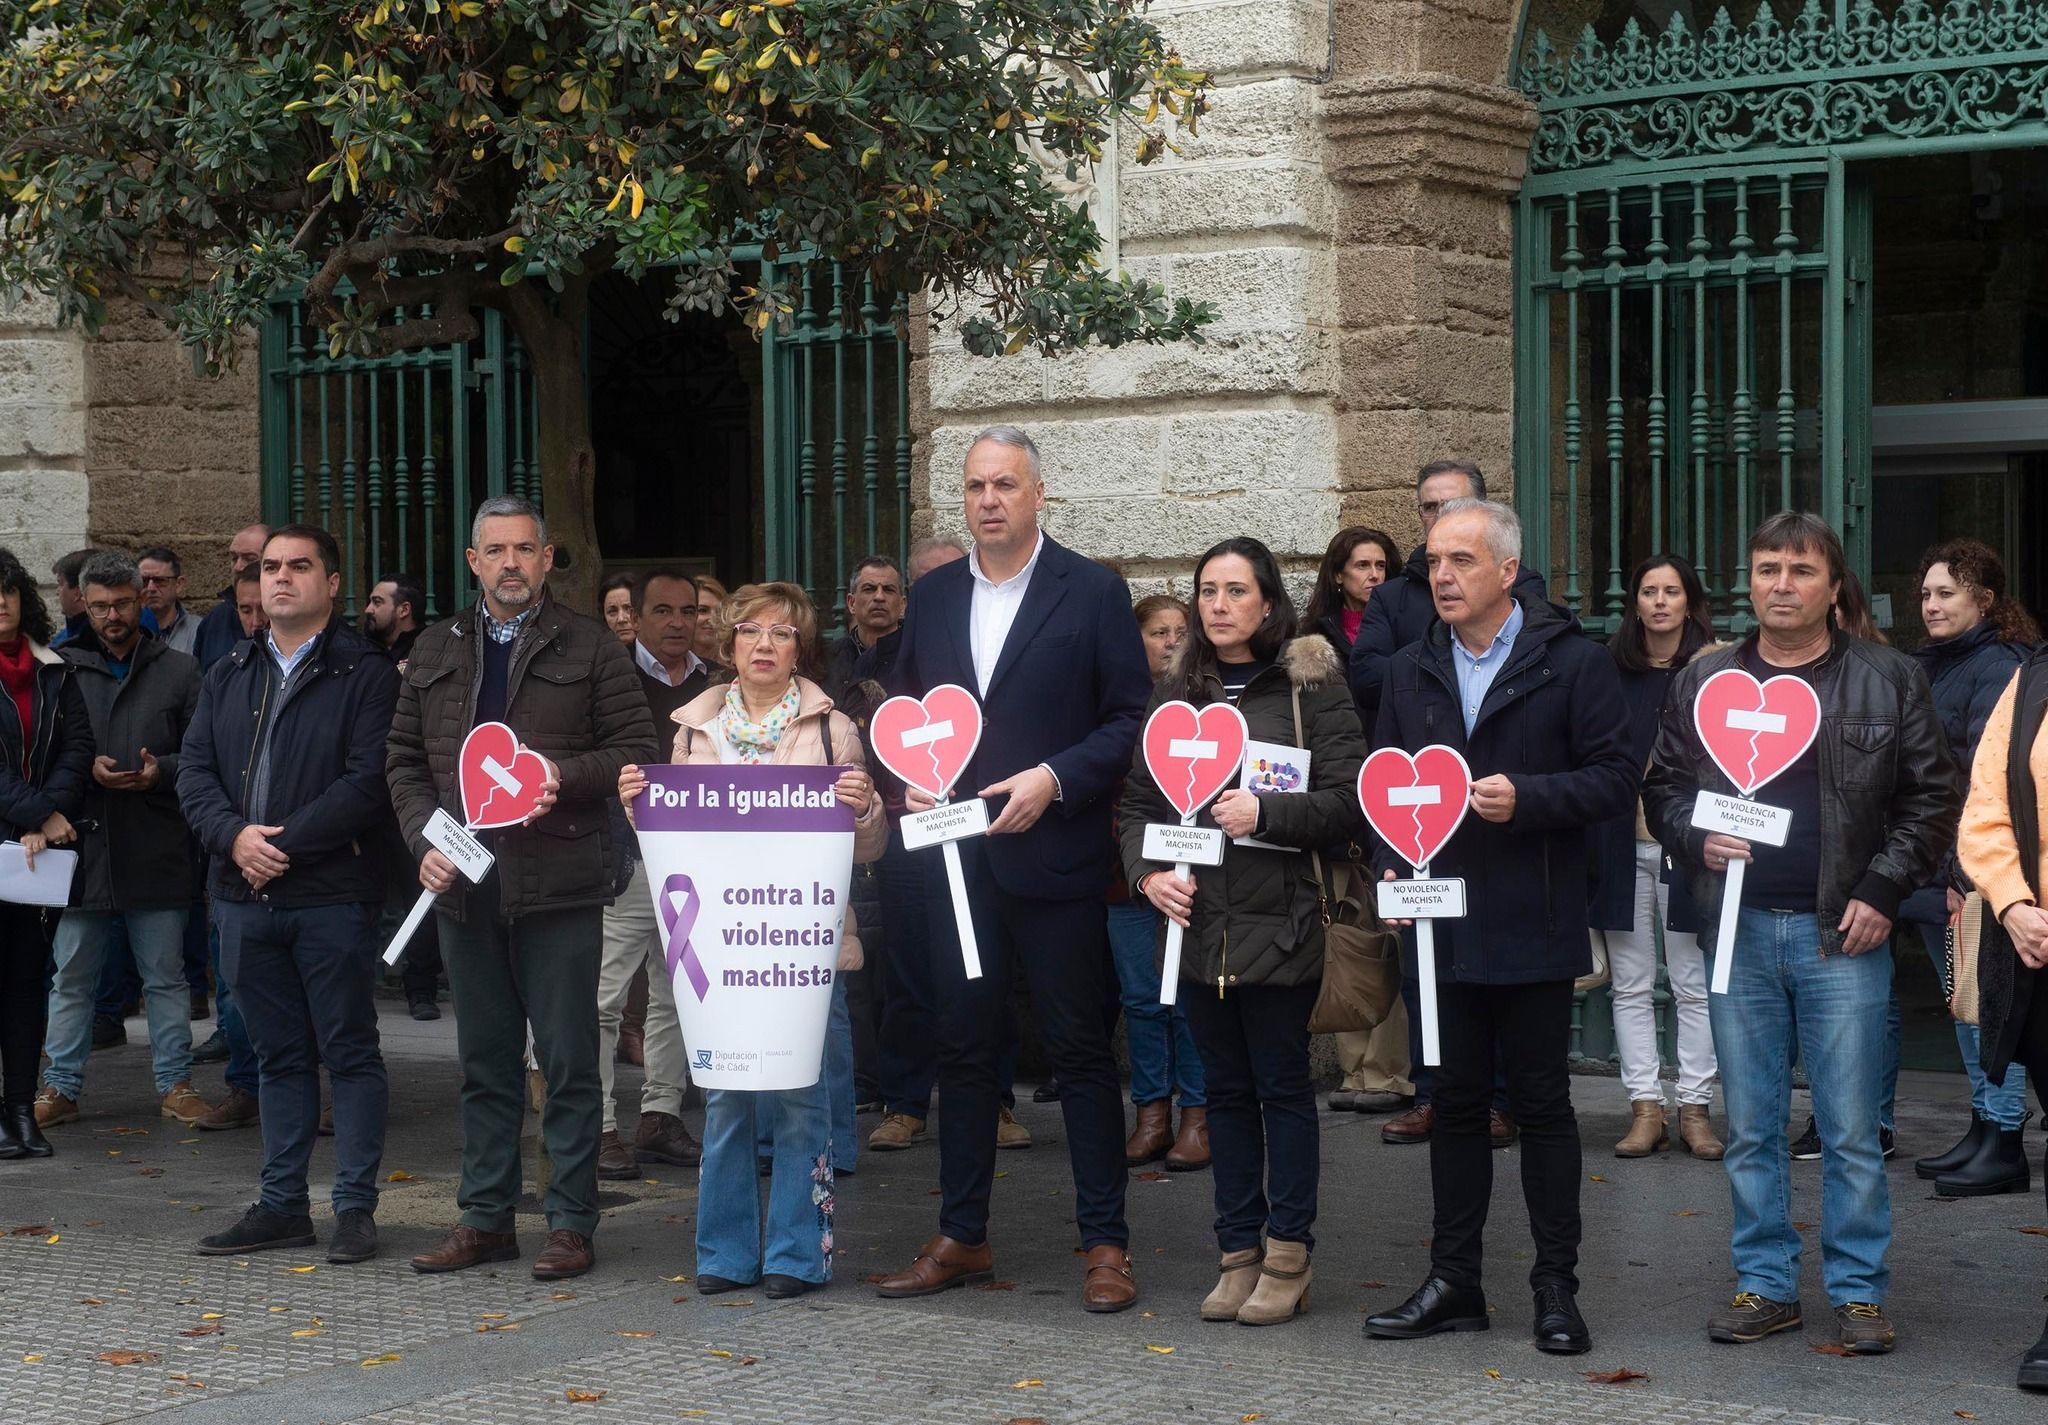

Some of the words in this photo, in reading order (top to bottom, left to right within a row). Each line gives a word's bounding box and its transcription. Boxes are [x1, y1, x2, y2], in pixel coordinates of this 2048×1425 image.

[649, 784, 690, 807] Por
[698, 784, 720, 807] la
[728, 784, 836, 815] igualdad
[1714, 798, 1729, 808] NO
[1730, 802, 1776, 819] VIOLENCIA
[916, 815, 929, 824] NO
[930, 805, 973, 820] VIOLENCIA
[1720, 811, 1765, 828] MACHISTA
[926, 817, 967, 832] MACHISTA
[442, 822, 453, 833] NO
[452, 830, 482, 860] VIOLENCIA
[1159, 829, 1171, 837] NO
[1172, 830, 1211, 840] VIOLENCIA
[442, 834, 471, 863] MACHISTA
[1165, 840, 1202, 850] MACHISTA
[723, 884, 803, 905] contra
[813, 882, 835, 906] la
[1393, 885, 1406, 893] NO
[1407, 884, 1450, 893] VIOLENCIA
[1401, 896, 1443, 904] MACHISTA
[722, 922, 834, 946] violencia
[722, 963, 832, 987] machista
[715, 1050, 758, 1061] Diputación
[715, 1063, 725, 1071] de
[727, 1063, 750, 1072] Cádiz
